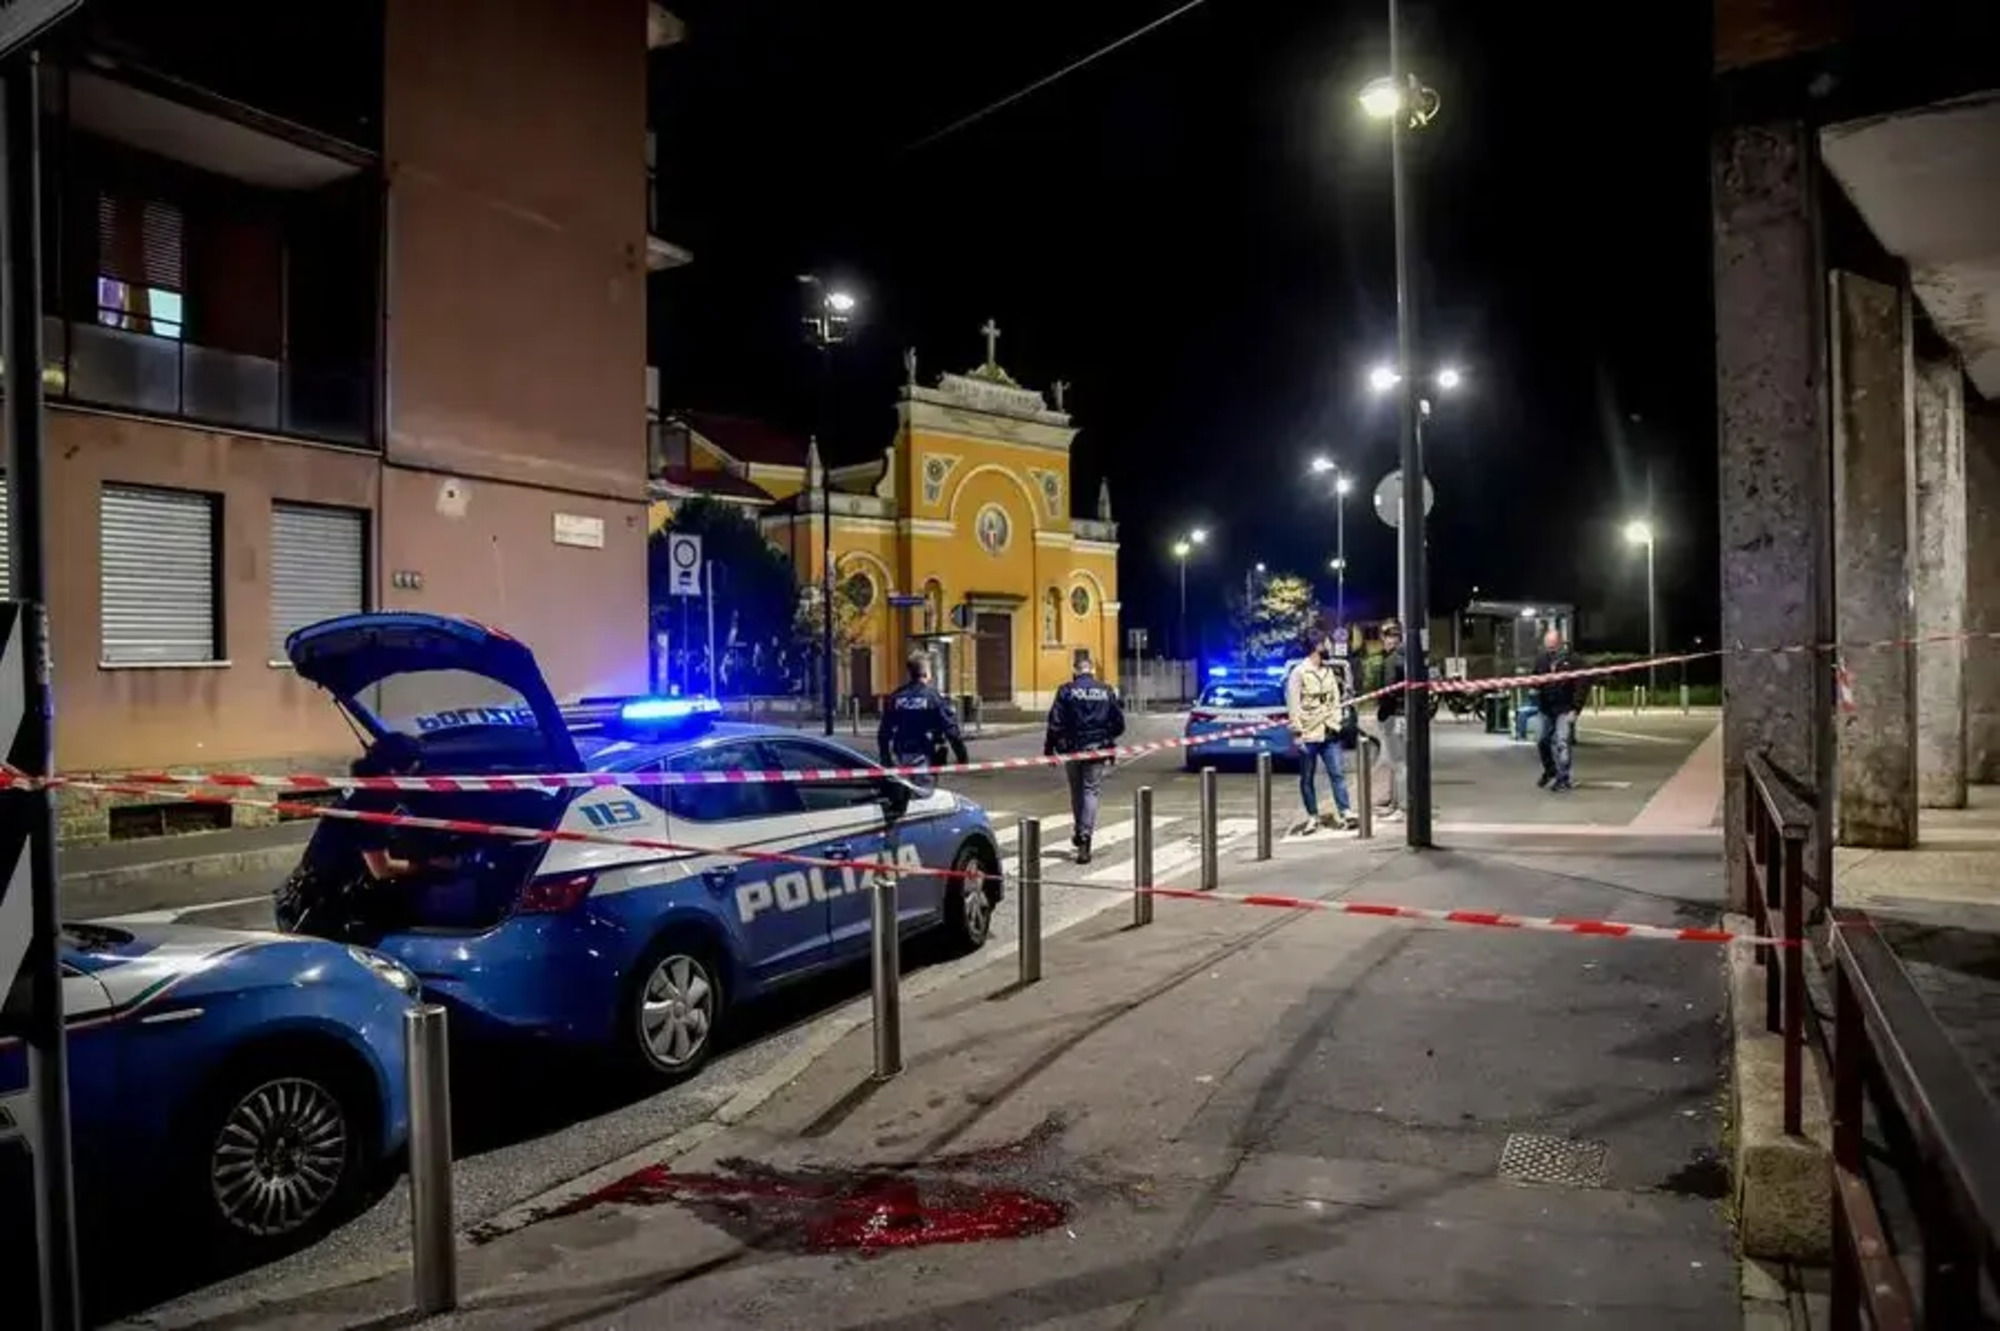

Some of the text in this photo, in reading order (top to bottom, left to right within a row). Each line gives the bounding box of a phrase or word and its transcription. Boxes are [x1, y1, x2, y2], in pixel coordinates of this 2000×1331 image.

[1071, 687, 1109, 701] POLIZIA
[579, 800, 642, 827] 113
[735, 844, 922, 923] POLIZIA
